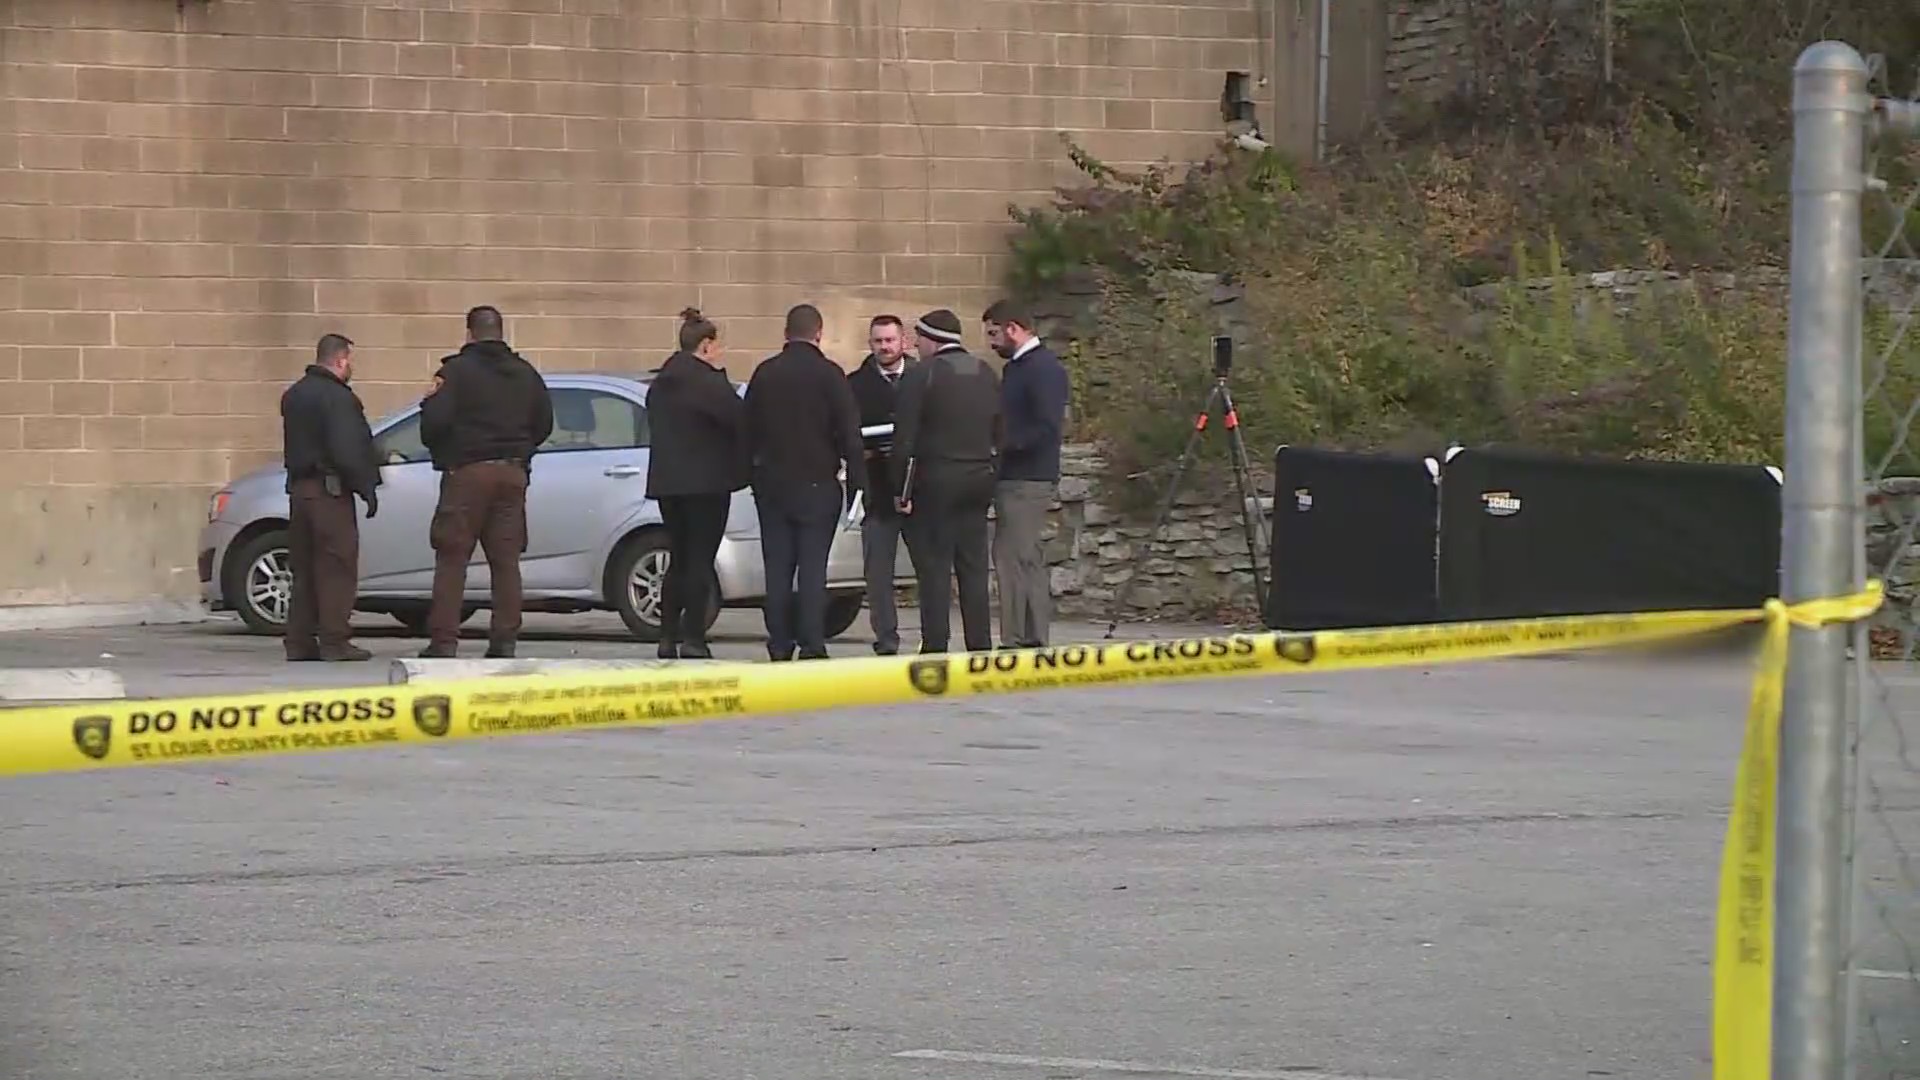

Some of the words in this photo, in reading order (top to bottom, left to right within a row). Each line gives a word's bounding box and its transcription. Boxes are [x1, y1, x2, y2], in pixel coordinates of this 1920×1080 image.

[970, 653, 1018, 673] DO
[1126, 636, 1254, 661] CROSS
[129, 710, 177, 734] DO
[190, 704, 267, 731] NOT
[276, 696, 396, 726] CROSS
